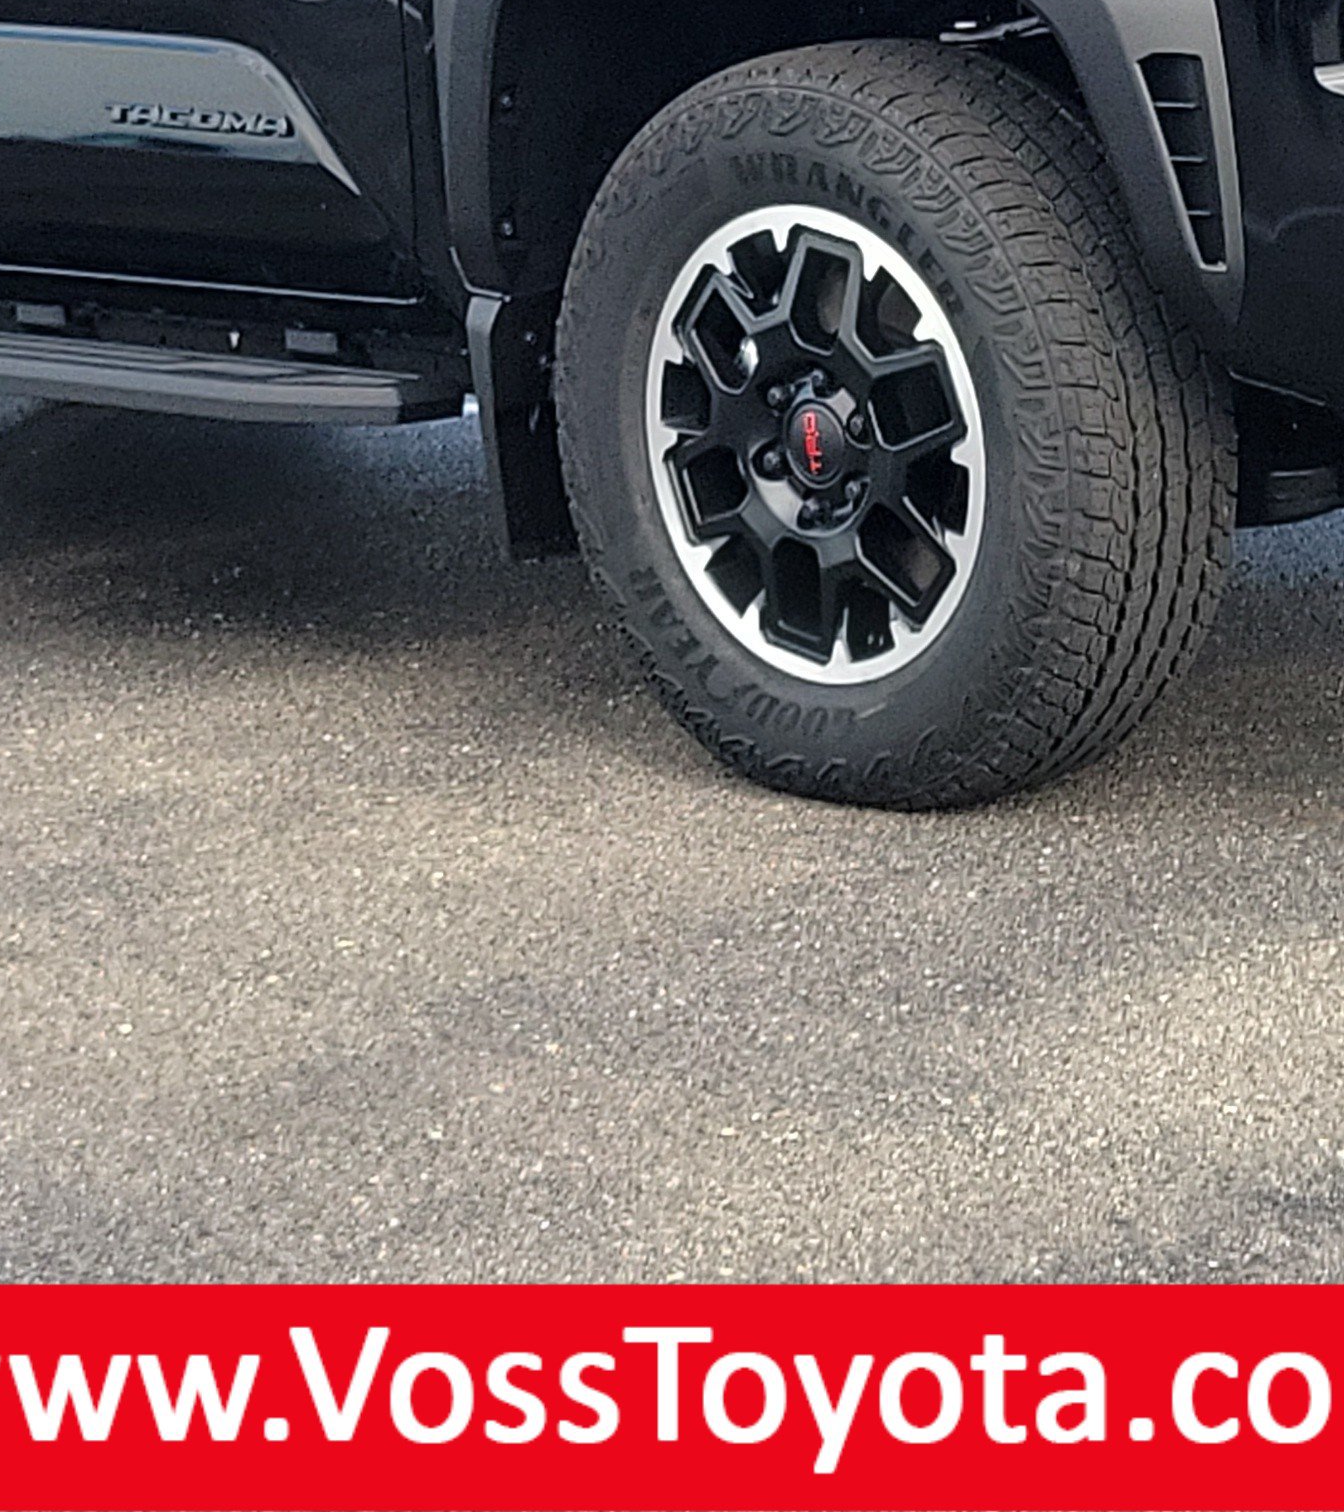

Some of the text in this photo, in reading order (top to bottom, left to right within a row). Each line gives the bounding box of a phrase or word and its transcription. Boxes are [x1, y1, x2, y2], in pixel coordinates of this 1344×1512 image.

[105, 103, 296, 138] TACOMA
[728, 150, 964, 314] WRANGLER
[802, 409, 823, 475] TRD
